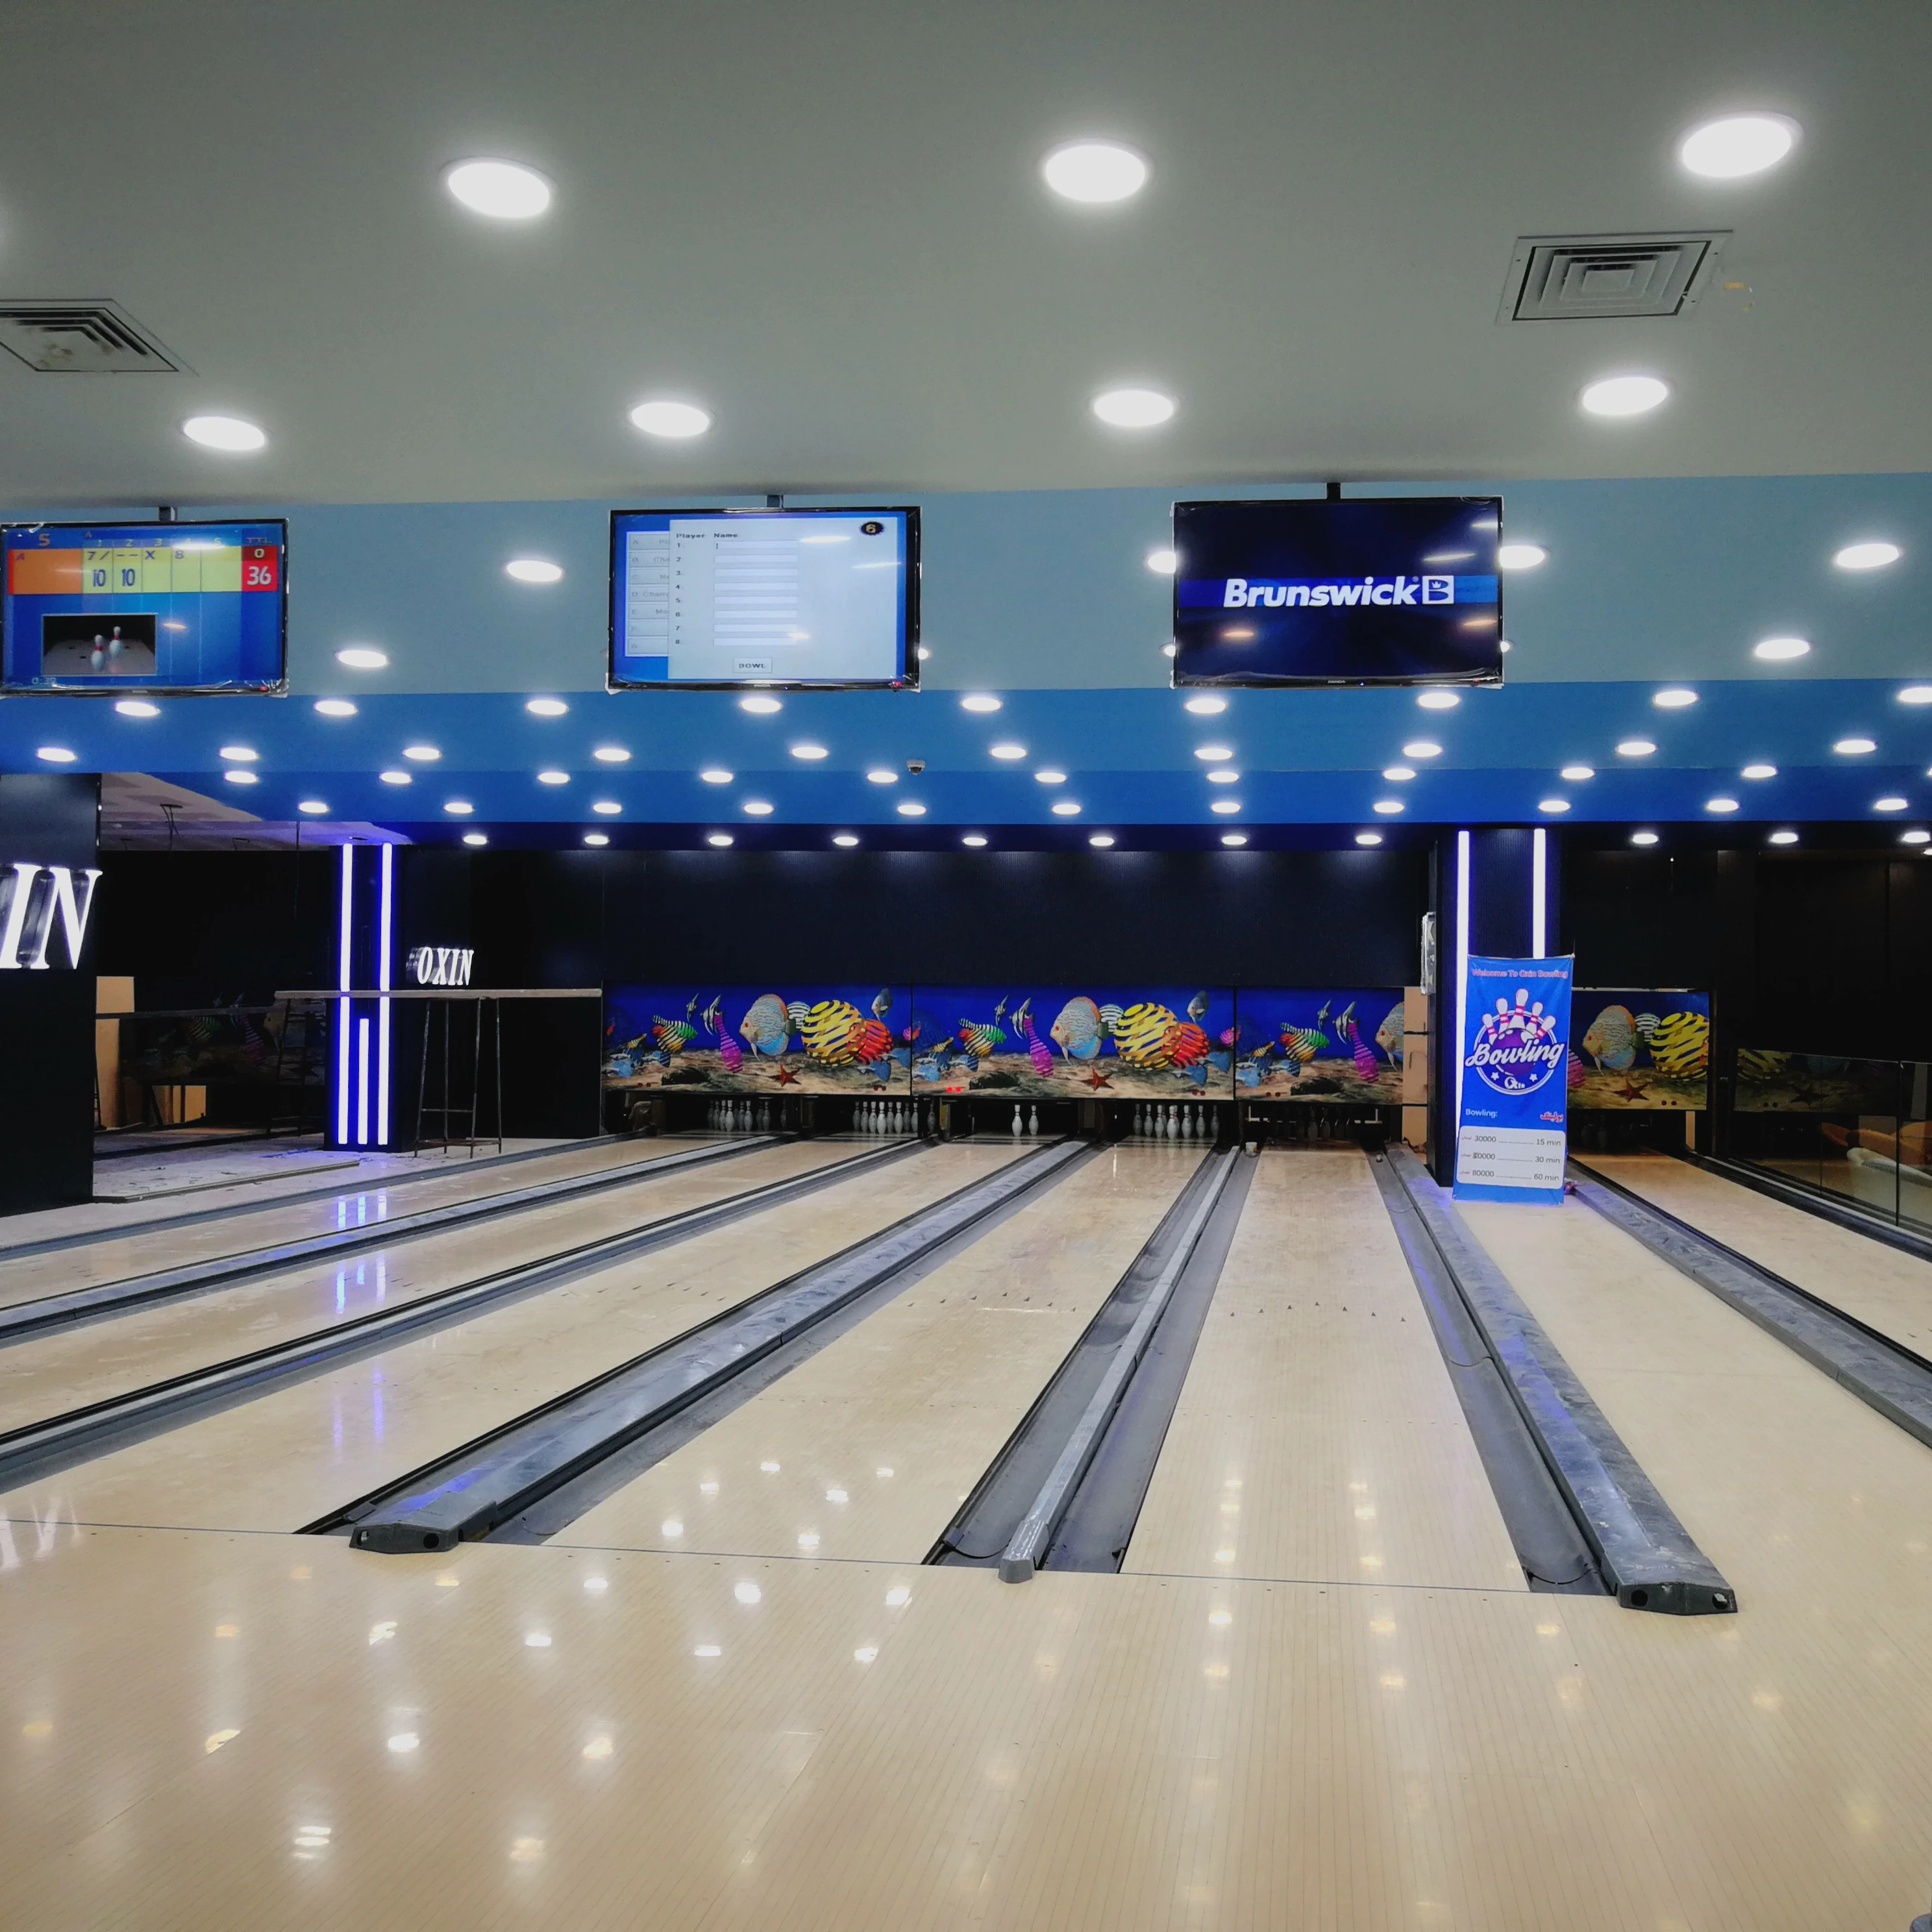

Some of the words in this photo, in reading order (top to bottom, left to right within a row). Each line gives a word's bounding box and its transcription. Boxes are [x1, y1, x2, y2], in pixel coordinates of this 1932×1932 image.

[865, 524, 876, 533] 6
[125, 539, 134, 547] 2
[155, 538, 162, 547] 3
[145, 550, 156, 560] X
[175, 551, 184, 560] 8
[254, 548, 265, 558] 0
[92, 569, 106, 588] 10
[121, 569, 136, 587] 10
[247, 565, 272, 586] 36
[1224, 575, 1420, 608] Brunswick
[0, 863, 103, 969] IN
[417, 947, 475, 985] OXIN
[1465, 1039, 1565, 1069] Bowling
